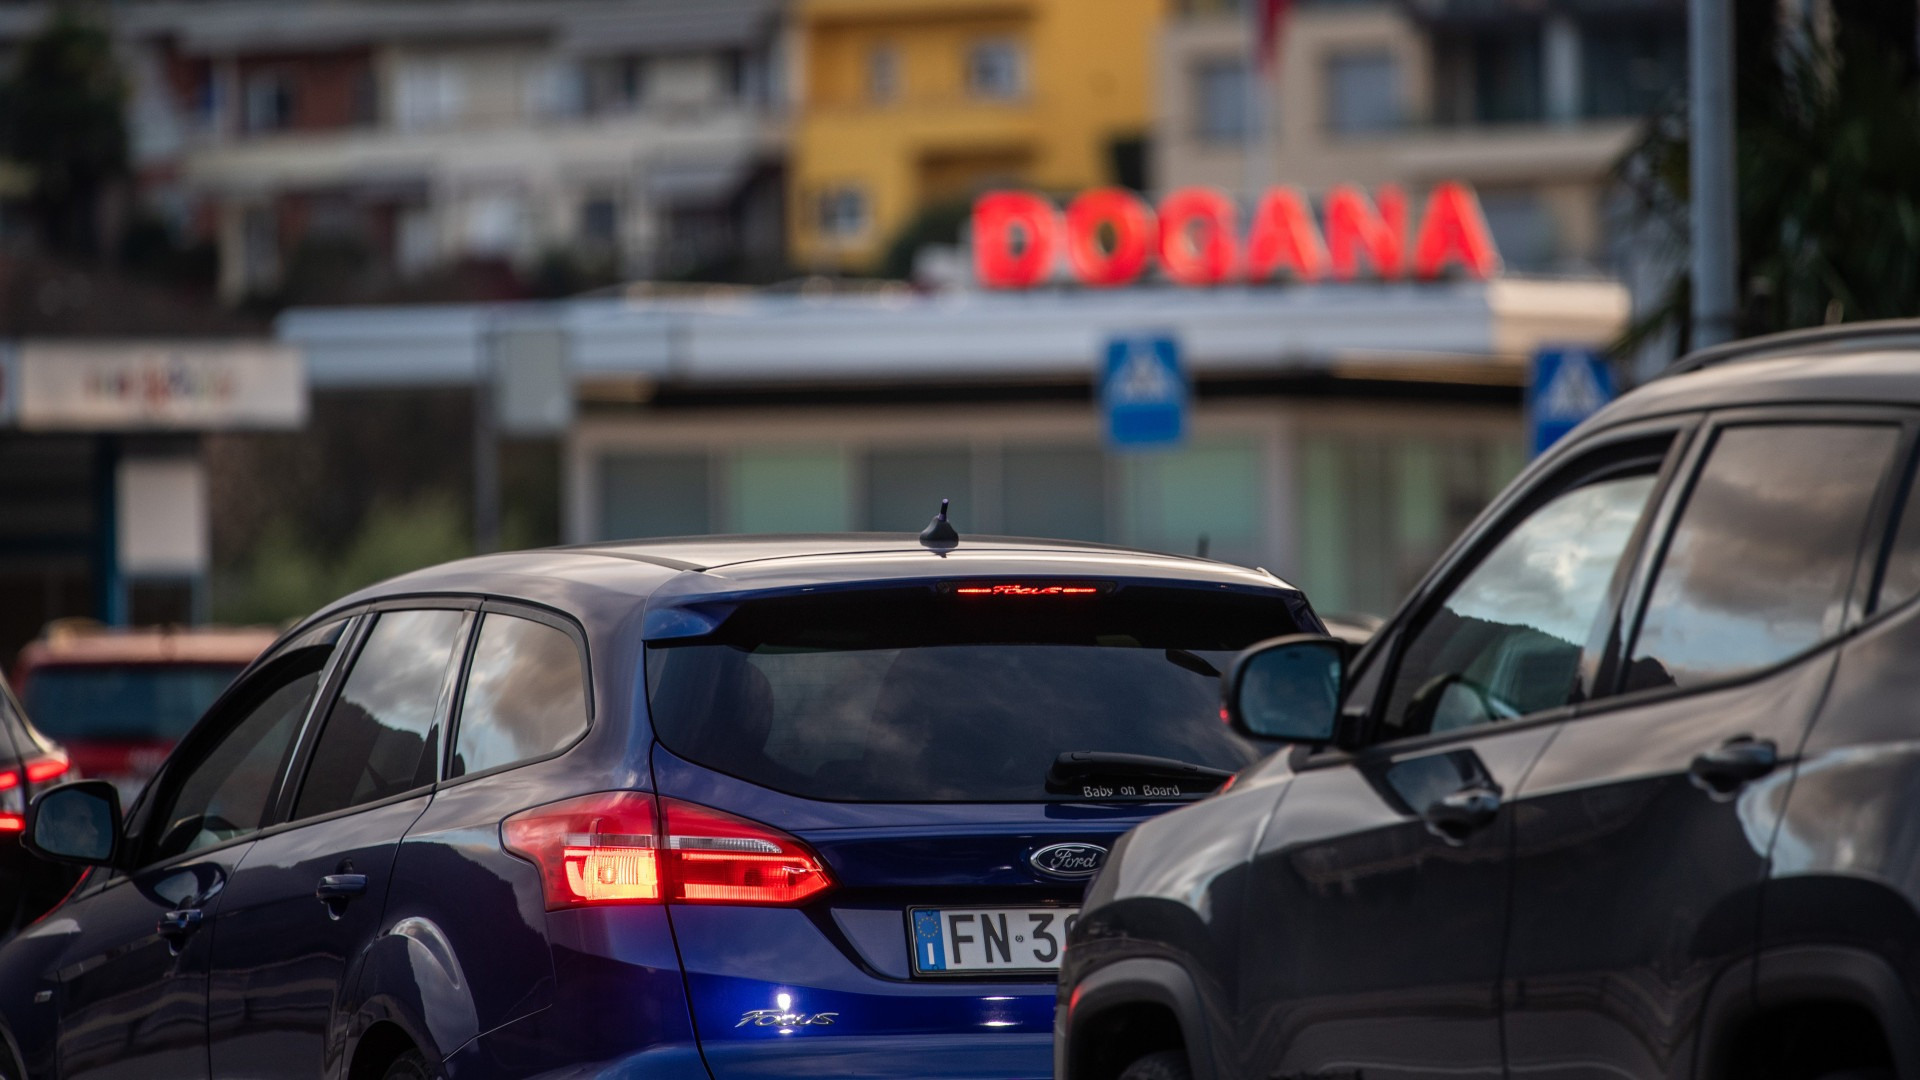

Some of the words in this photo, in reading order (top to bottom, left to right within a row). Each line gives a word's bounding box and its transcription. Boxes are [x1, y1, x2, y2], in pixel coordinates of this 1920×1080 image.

[973, 180, 1500, 290] DOGANA
[1083, 785, 1113, 798] Baby
[1120, 785, 1136, 796] on
[1143, 784, 1180, 797] Board
[1050, 848, 1097, 869] Ford
